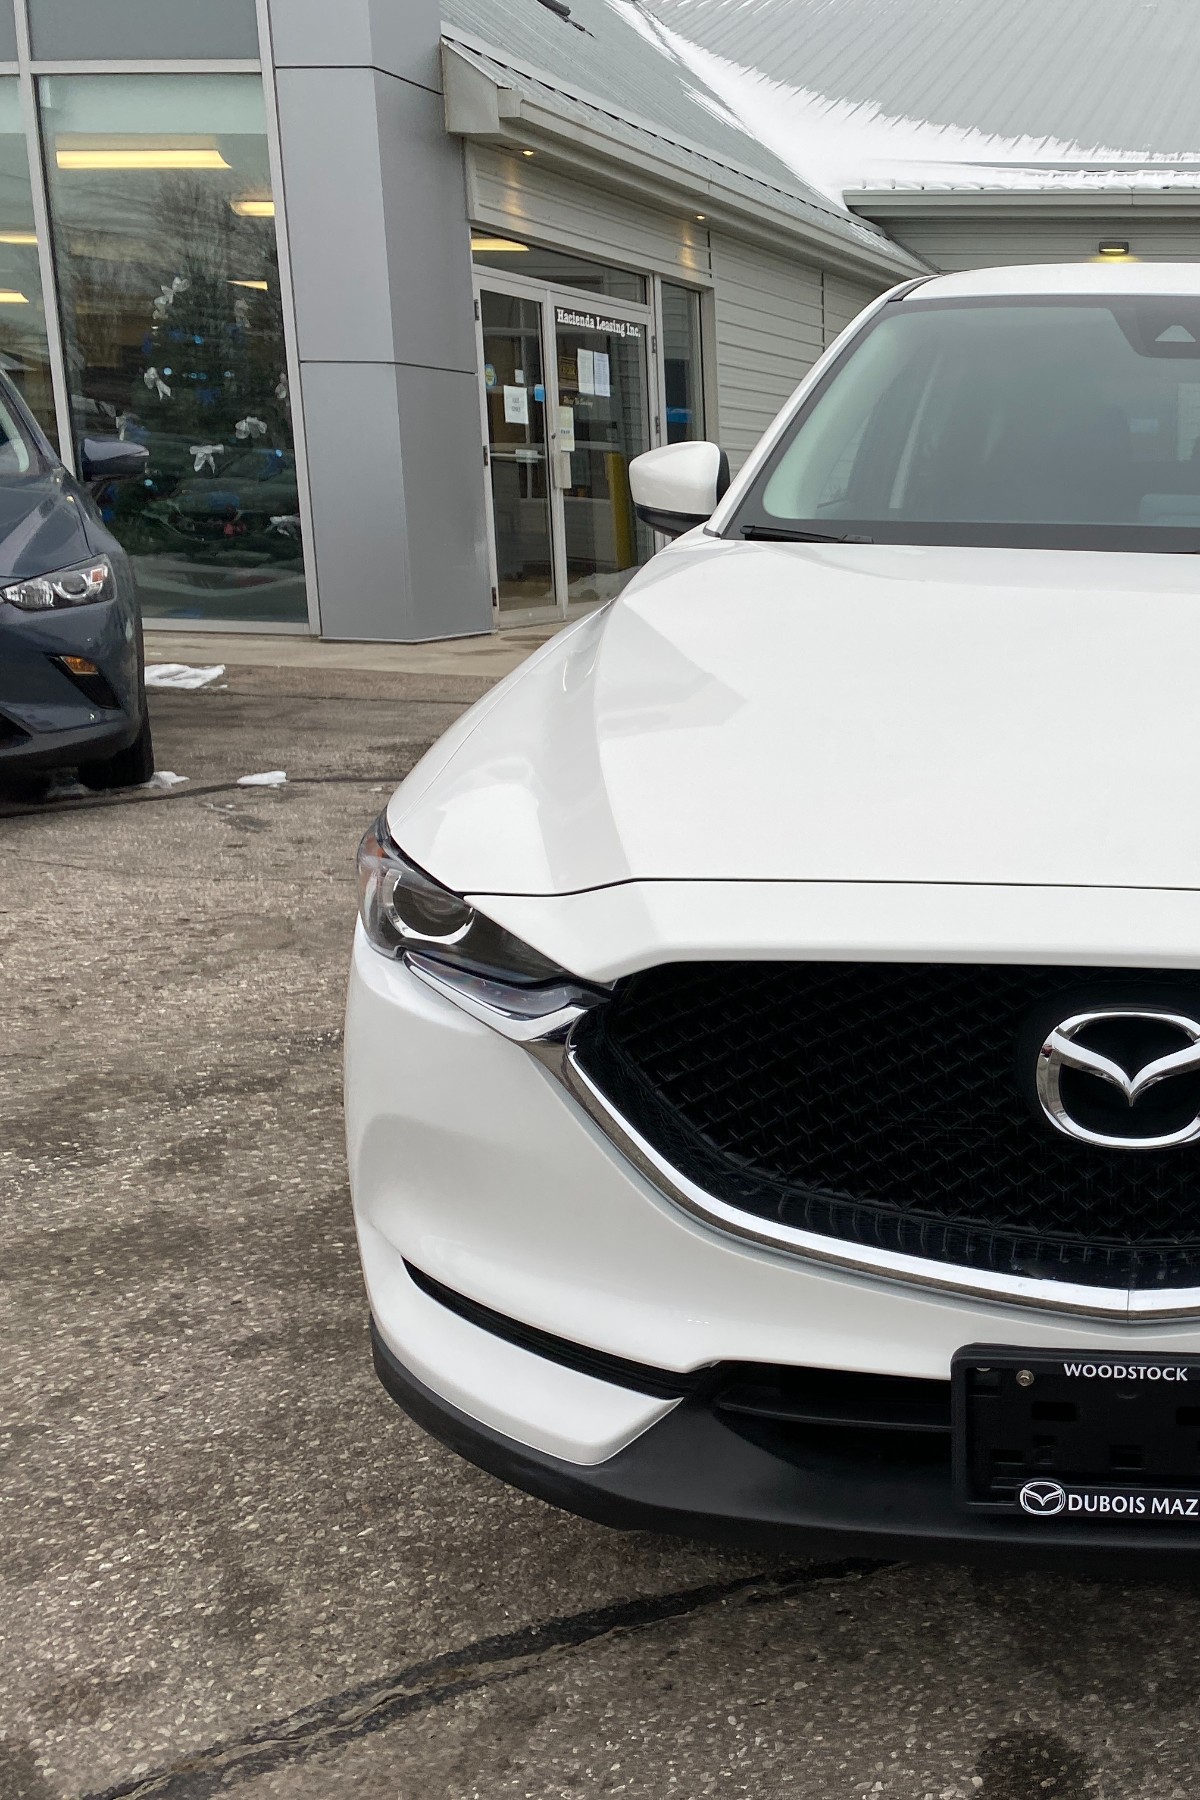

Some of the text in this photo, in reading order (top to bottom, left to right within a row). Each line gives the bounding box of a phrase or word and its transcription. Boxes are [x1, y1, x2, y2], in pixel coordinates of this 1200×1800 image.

[557, 309, 641, 338] Hacienda Leasing Inc.
[1063, 1363, 1188, 1382] WOODSTOCK
[1067, 1494, 1146, 1514] DUBOIS
